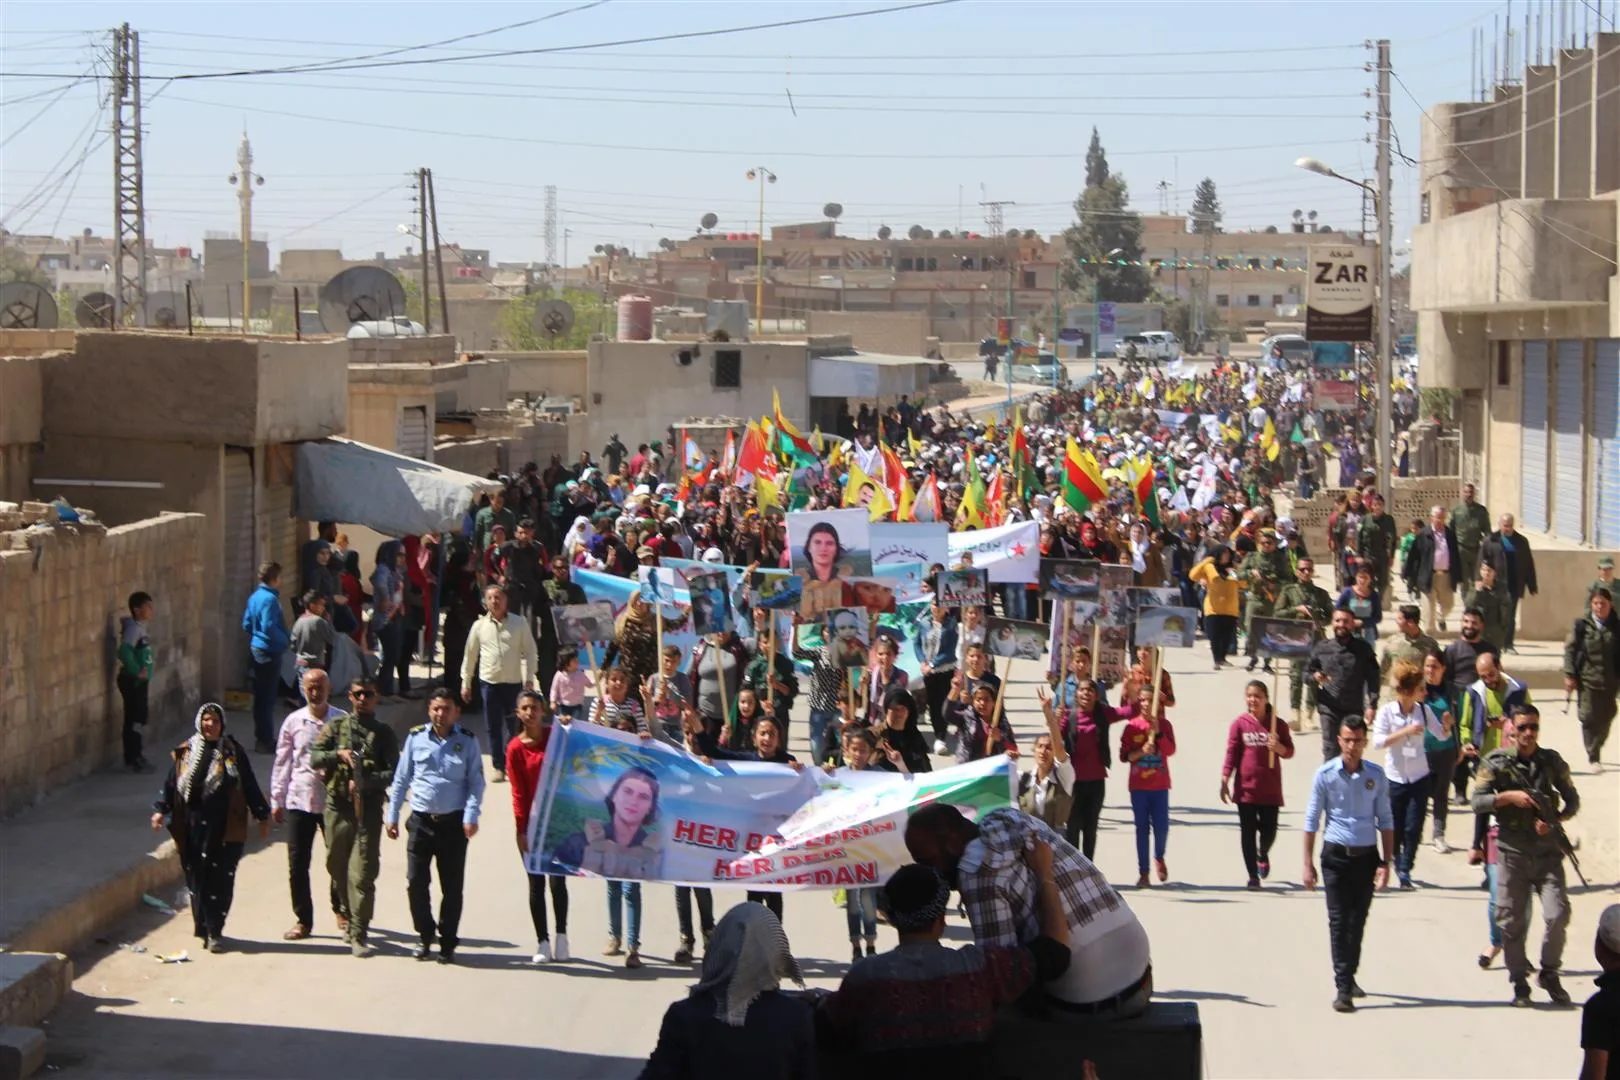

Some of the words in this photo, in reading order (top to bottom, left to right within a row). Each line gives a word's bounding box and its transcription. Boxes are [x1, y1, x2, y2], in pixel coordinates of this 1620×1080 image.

[1314, 262, 1368, 284] ZAR
[673, 818, 738, 852] HER
[713, 855, 775, 880] HER
